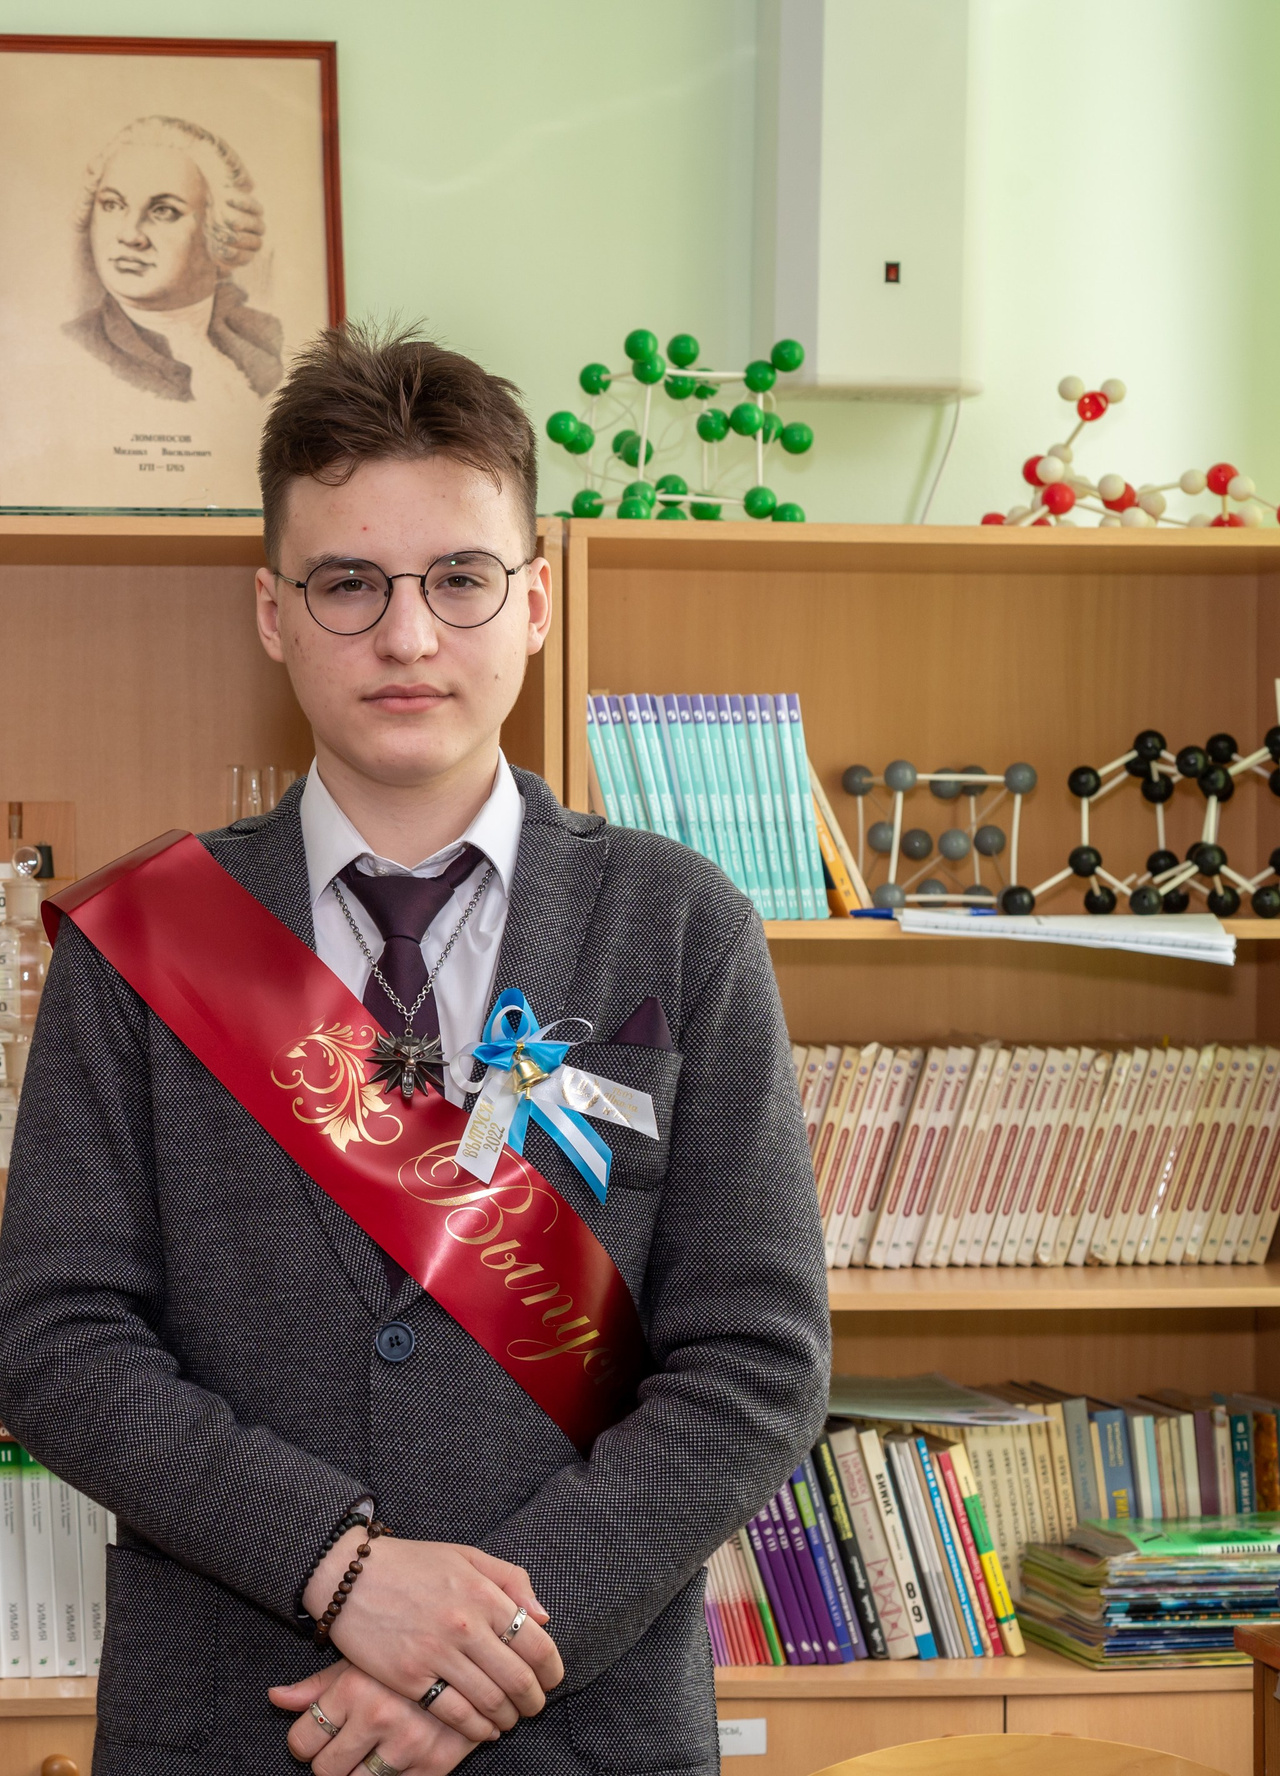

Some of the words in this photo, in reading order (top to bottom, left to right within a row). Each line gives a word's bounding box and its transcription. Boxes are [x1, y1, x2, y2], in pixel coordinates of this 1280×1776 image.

[130, 434, 192, 443] ЛОМОНОСОВ
[463, 1098, 495, 1159] ВЫПУСК
[483, 1122, 506, 1153] 2022
[398, 1140, 619, 1385] Выпус
[1, 1450, 11, 1462] 11
[875, 1472, 894, 1516] ХИМИЯ
[9, 1602, 20, 1641] ХИМИЯ
[36, 1603, 47, 1642] ХИМИЯ
[65, 1604, 76, 1643] ХИМИЯ
